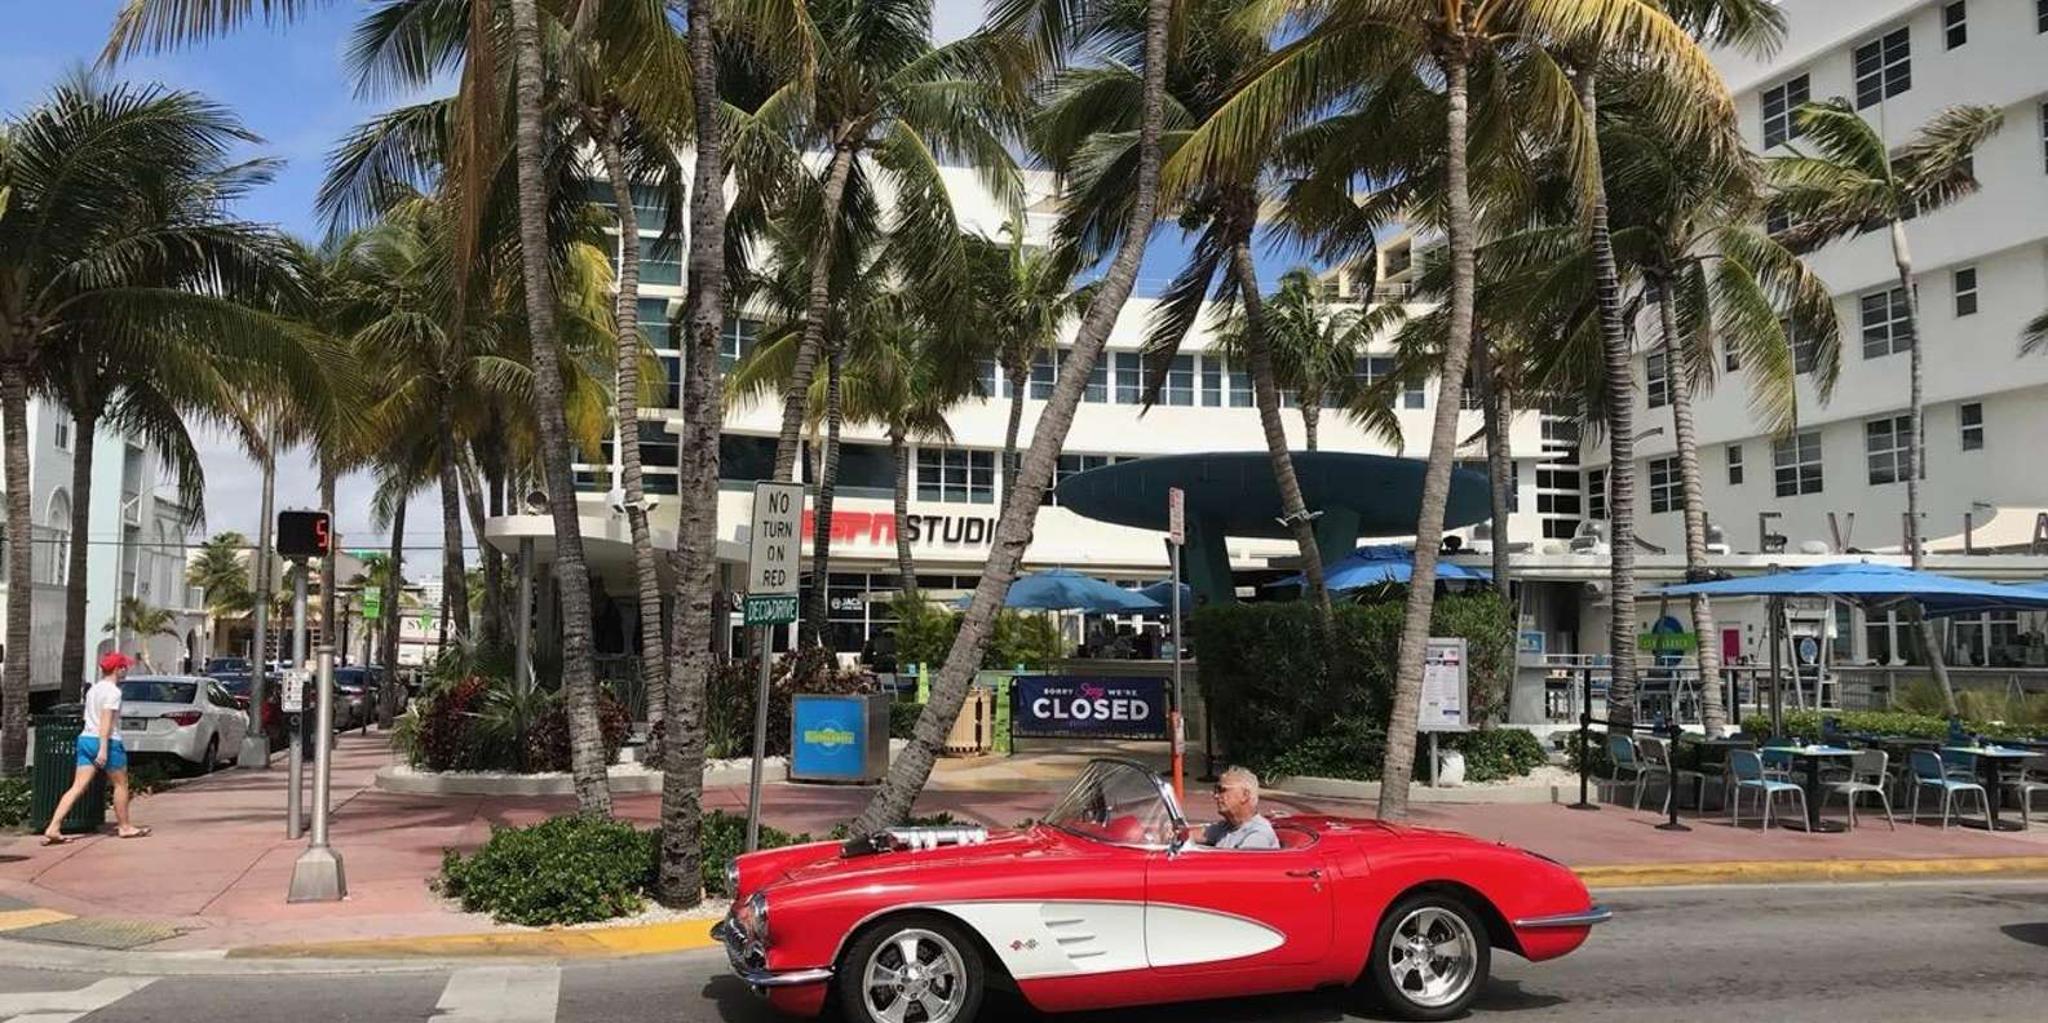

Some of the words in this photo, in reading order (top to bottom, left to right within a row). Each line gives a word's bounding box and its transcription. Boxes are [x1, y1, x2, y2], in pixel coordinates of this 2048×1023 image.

[768, 491, 790, 514] NO
[315, 519, 328, 548] 5
[763, 521, 793, 539] TURN
[767, 545, 785, 561] ON
[762, 570, 786, 588] RED
[1043, 687, 1074, 696] SORRY
[1032, 697, 1150, 720] CLOSED
